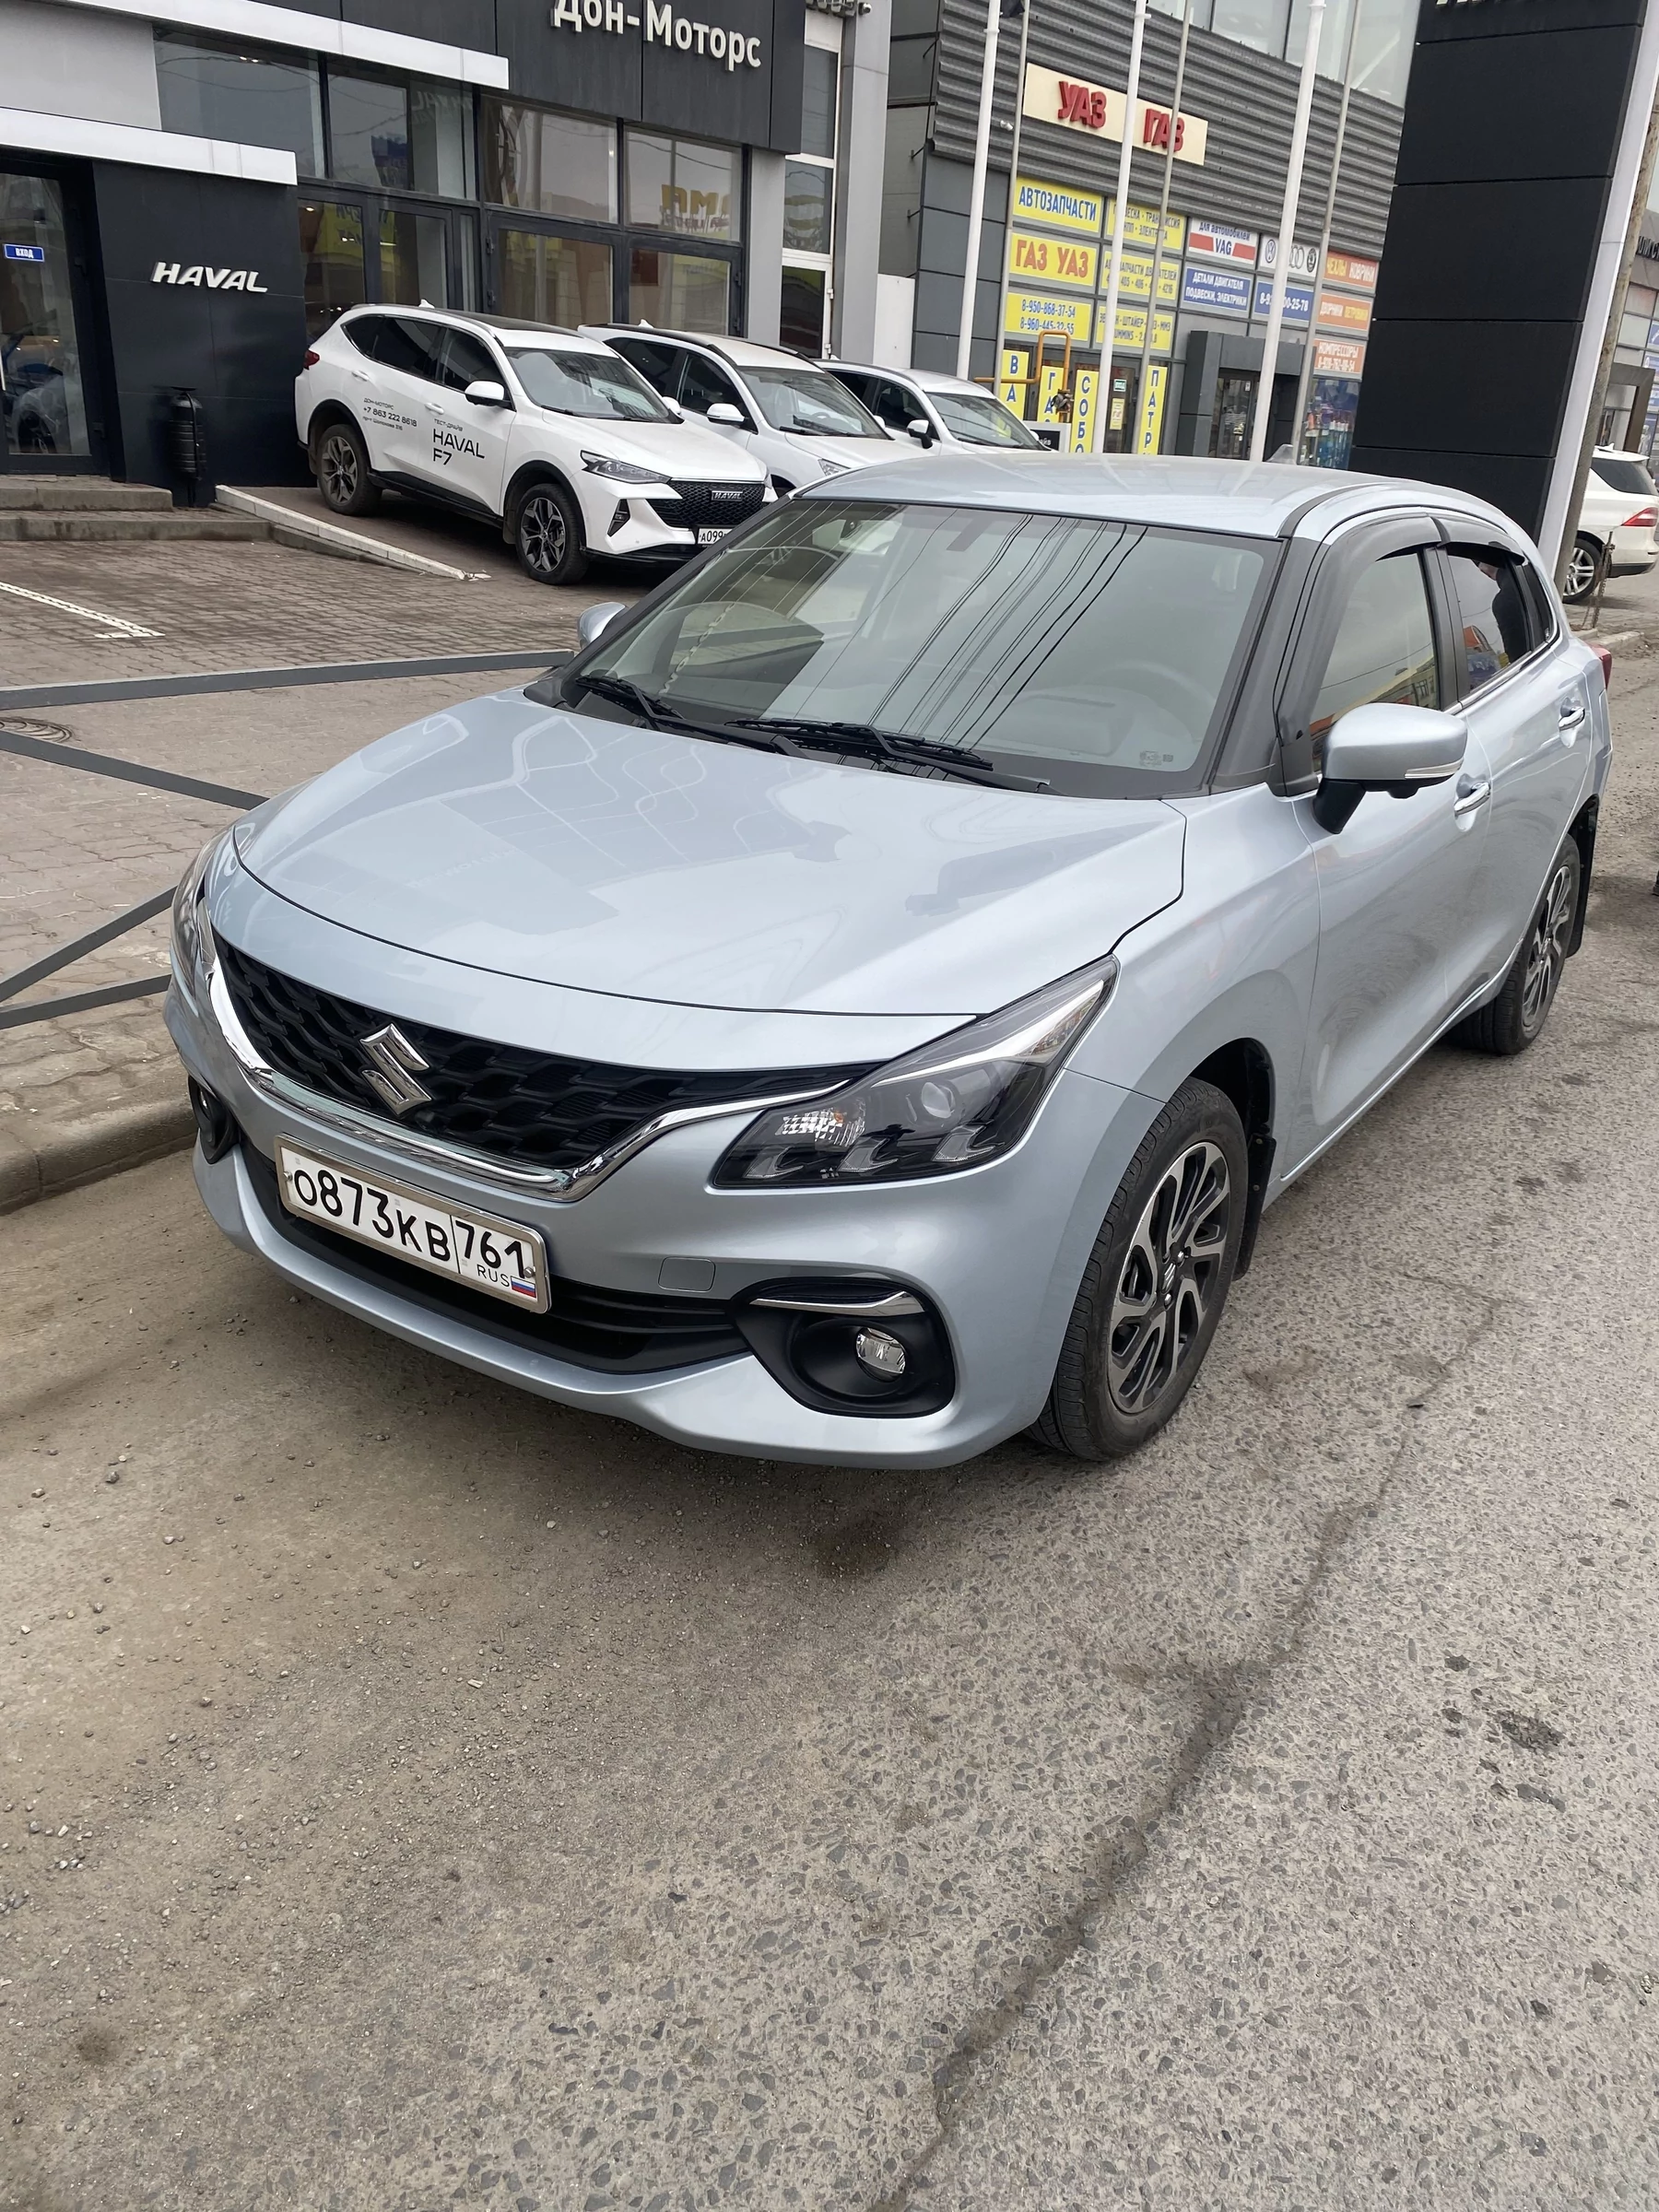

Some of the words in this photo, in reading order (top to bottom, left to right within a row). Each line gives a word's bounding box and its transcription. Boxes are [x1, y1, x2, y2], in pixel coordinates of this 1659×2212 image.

[550, 0, 761, 72] Дон-Моторс
[1058, 81, 1107, 128] УАЗ
[1144, 109, 1185, 152] ГАЗ
[1018, 186, 1097, 222] АВТОЗАПЧАСТИ
[1146, 211, 1181, 229] ТРАНИССИЯ
[15, 247, 35, 259] ВХОД
[1215, 238, 1232, 255] VAG
[1016, 240, 1048, 271] ГАЗ
[1057, 247, 1088, 278] УАЗ
[150, 262, 268, 293] HAVAL
[1192, 272, 1214, 285] ДЕТАЛИ
[1214, 275, 1244, 290] ДВИГАТЕЛЯ
[1217, 292, 1247, 306] ЭЛЕКТРИКИ
[1022, 300, 1076, 318] 8-950-868-37-54
[372, 408, 387, 418] 863
[387, 412, 401, 422] 222
[401, 416, 418, 427] 8618
[433, 429, 485, 459] HAVAL
[433, 448, 453, 465] F7
[700, 530, 725, 542] А099
[455, 1219, 525, 1278] 761
[477, 1264, 510, 1288] RUS
